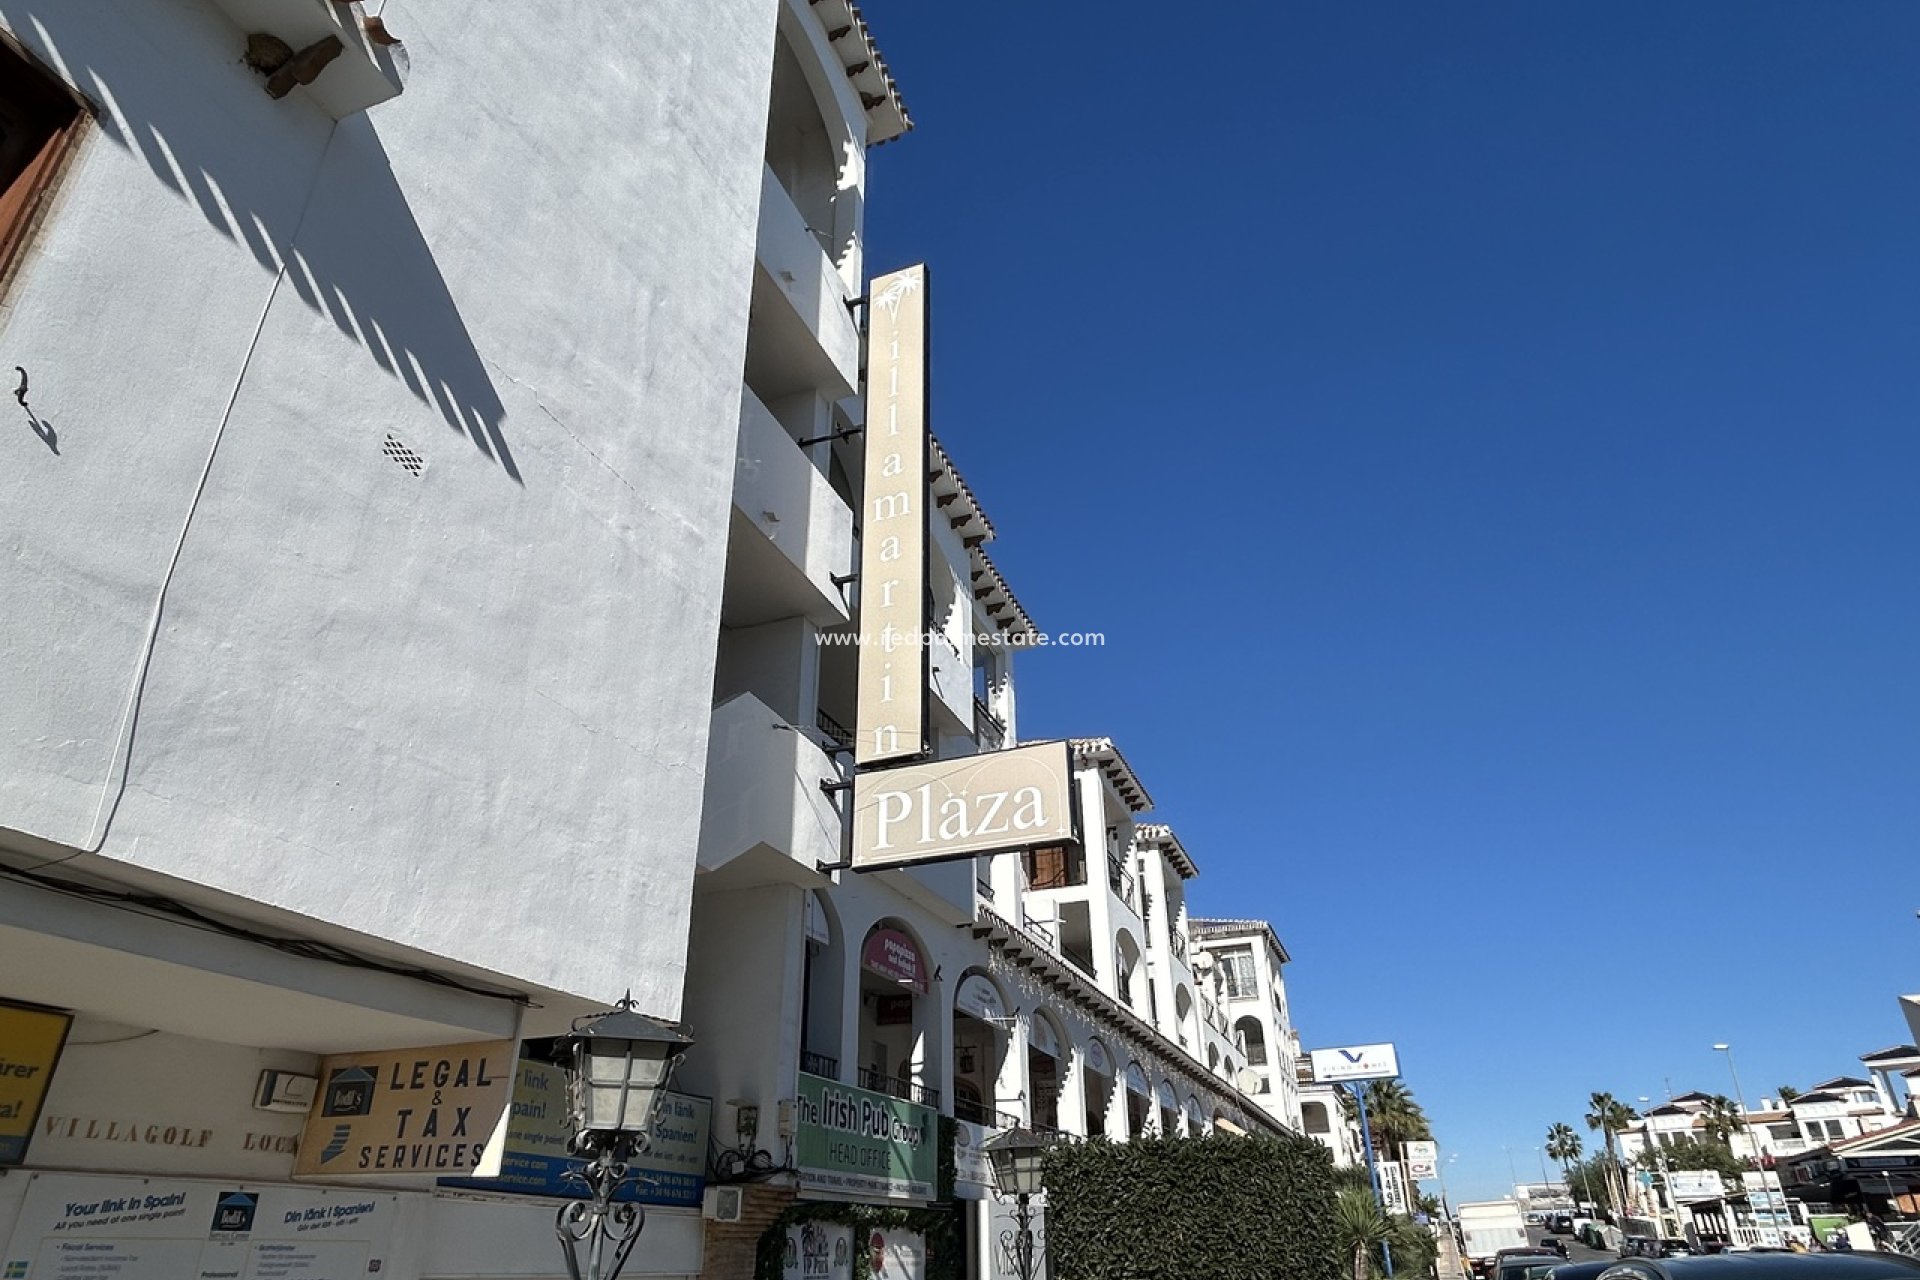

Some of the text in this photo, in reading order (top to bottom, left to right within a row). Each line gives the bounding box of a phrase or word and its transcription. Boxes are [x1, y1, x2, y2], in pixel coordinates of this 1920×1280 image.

[872, 784, 1048, 850] Plaza
[389, 1058, 492, 1090] LEGAL
[524, 1069, 549, 1090] link
[431, 1090, 443, 1105] &
[511, 1100, 547, 1121] pain!
[396, 1107, 472, 1139] TAX
[797, 1096, 818, 1125] The
[822, 1088, 858, 1133] Irish
[861, 1099, 890, 1139] Pub
[46, 1116, 213, 1148] VILLAGOLF
[358, 1143, 485, 1168] SERVICES
[830, 1143, 891, 1170] HEAD OFFICE
[65, 1192, 186, 1217] Your link in Spain!
[284, 1210, 302, 1223] Din
